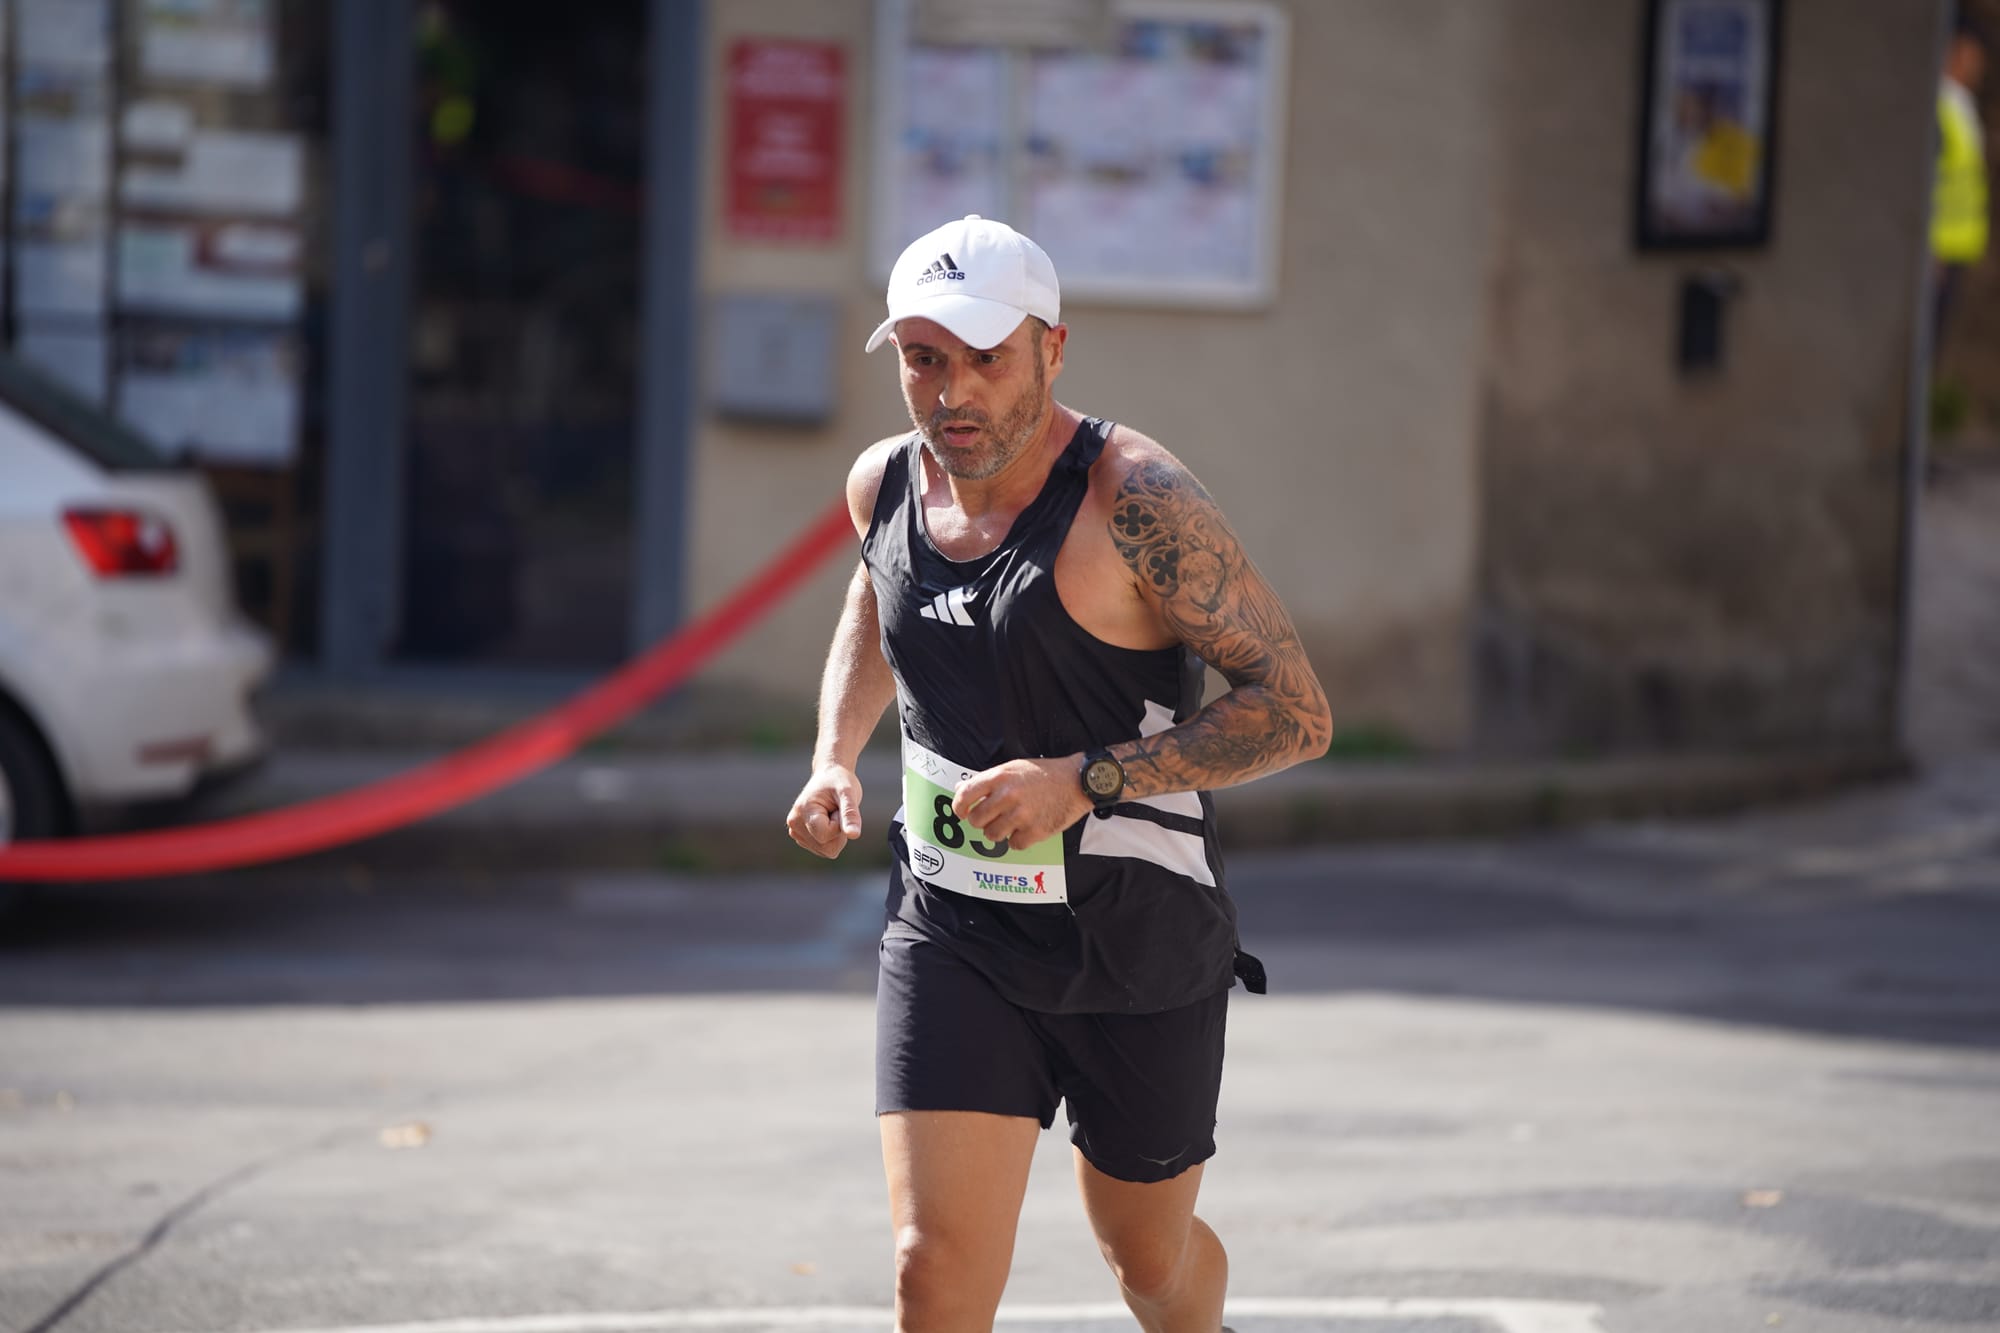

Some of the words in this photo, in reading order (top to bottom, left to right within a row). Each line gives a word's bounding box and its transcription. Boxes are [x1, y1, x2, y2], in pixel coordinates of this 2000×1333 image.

[916, 270, 966, 286] adidas
[972, 870, 1029, 887] TUFF'S
[979, 880, 1035, 894] Aventure
